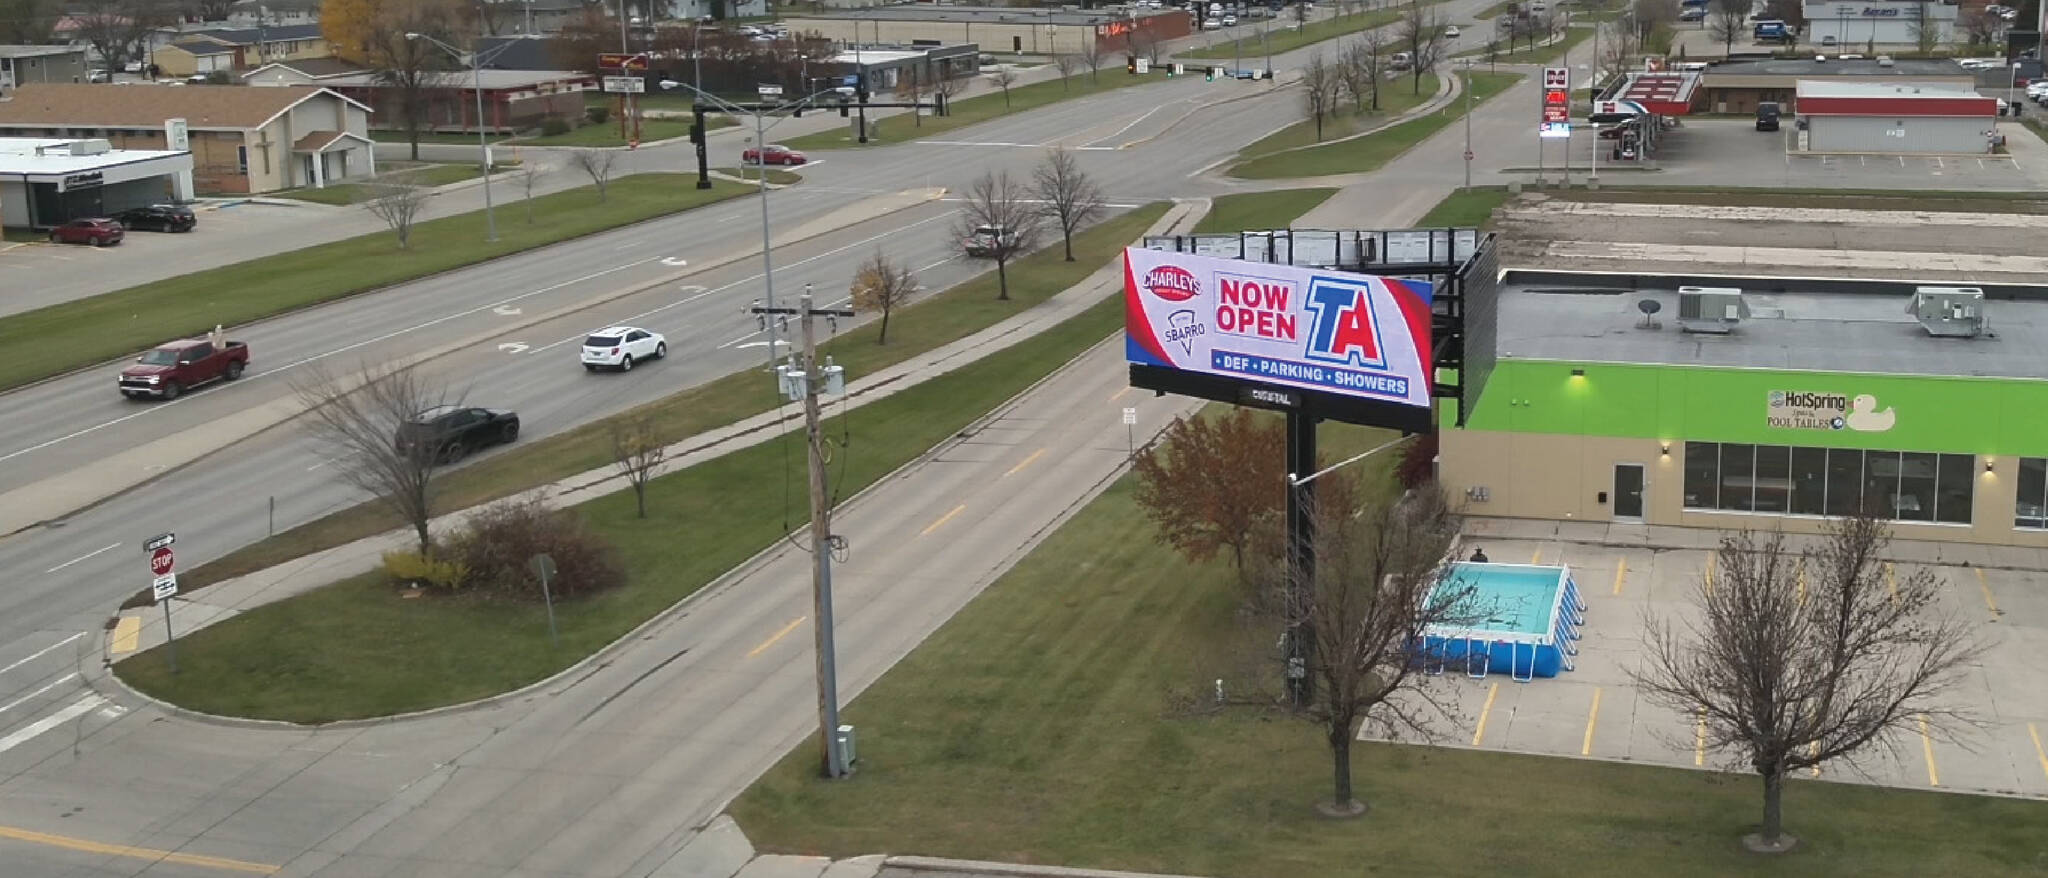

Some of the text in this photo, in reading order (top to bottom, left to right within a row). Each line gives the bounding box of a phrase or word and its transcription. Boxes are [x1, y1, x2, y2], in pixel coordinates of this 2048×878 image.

[1143, 271, 1202, 295] CHARLEYS
[1220, 278, 1289, 312] NOW
[1165, 323, 1205, 342] SBARRO
[1217, 305, 1296, 340] OPEN
[1307, 278, 1385, 367] TA
[1224, 356, 1406, 394] DEF PARKING SHOWERS
[1785, 391, 1845, 411] HotSpring
[1768, 416, 1828, 428] POOL TABLES
[152, 553, 172, 570] STOP
